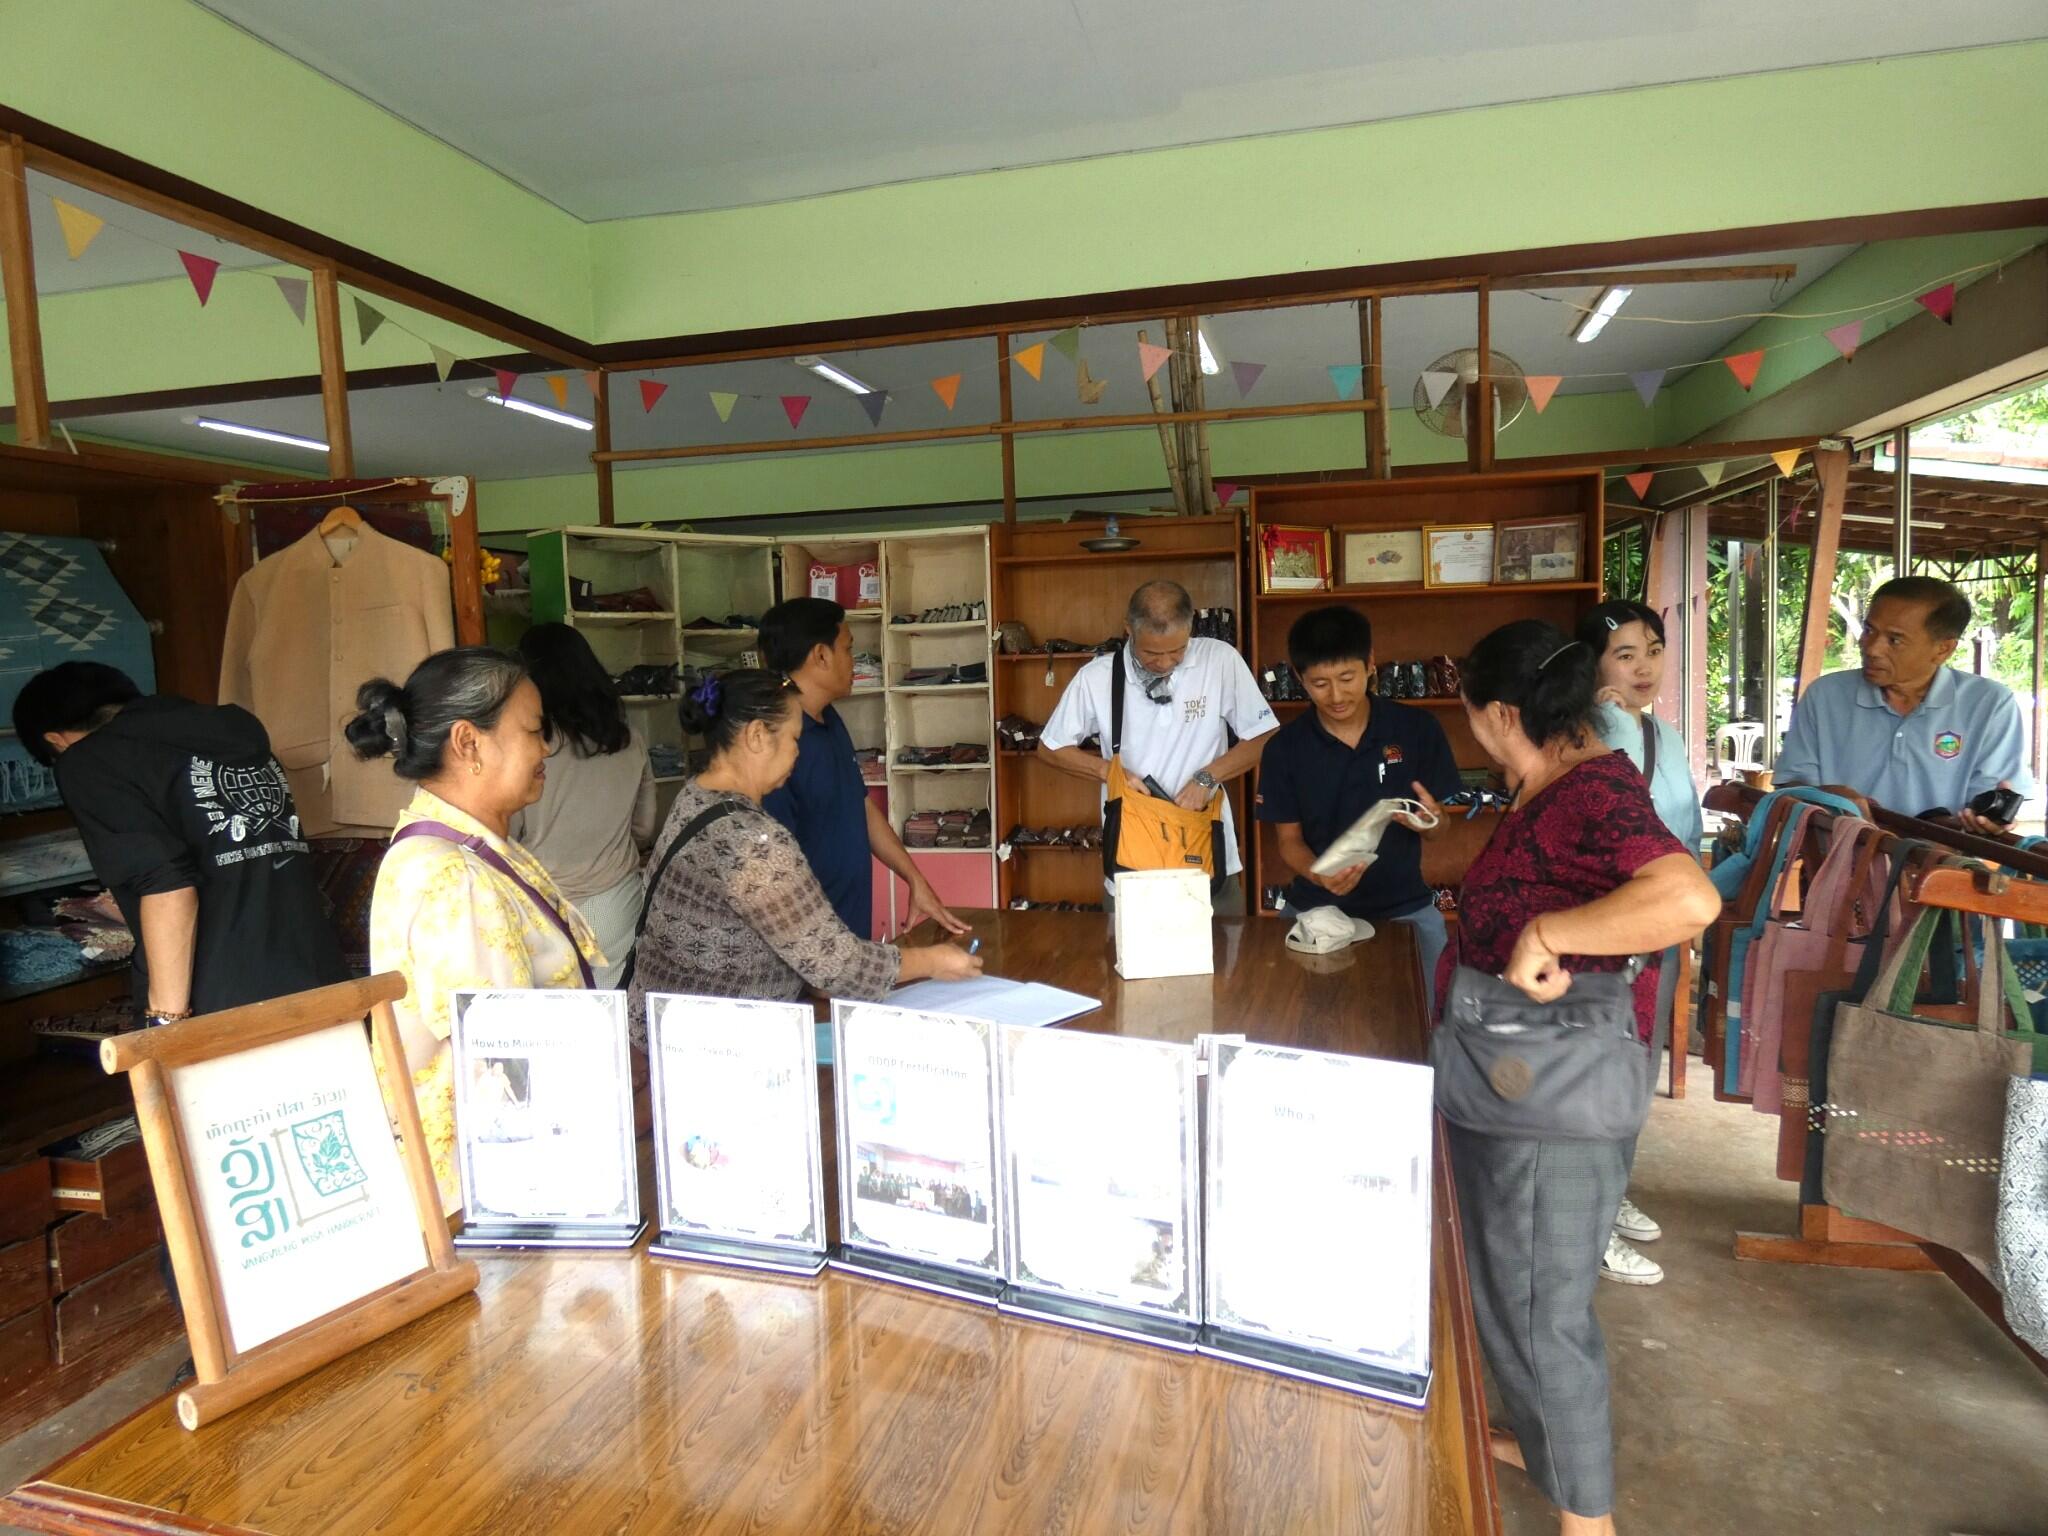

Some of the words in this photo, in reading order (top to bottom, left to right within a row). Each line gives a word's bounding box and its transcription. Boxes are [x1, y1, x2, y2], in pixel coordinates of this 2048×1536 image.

[190, 756, 217, 799] NEVE
[472, 1038, 495, 1049] How
[498, 1039, 510, 1049] to
[1273, 1104, 1303, 1121] Who
